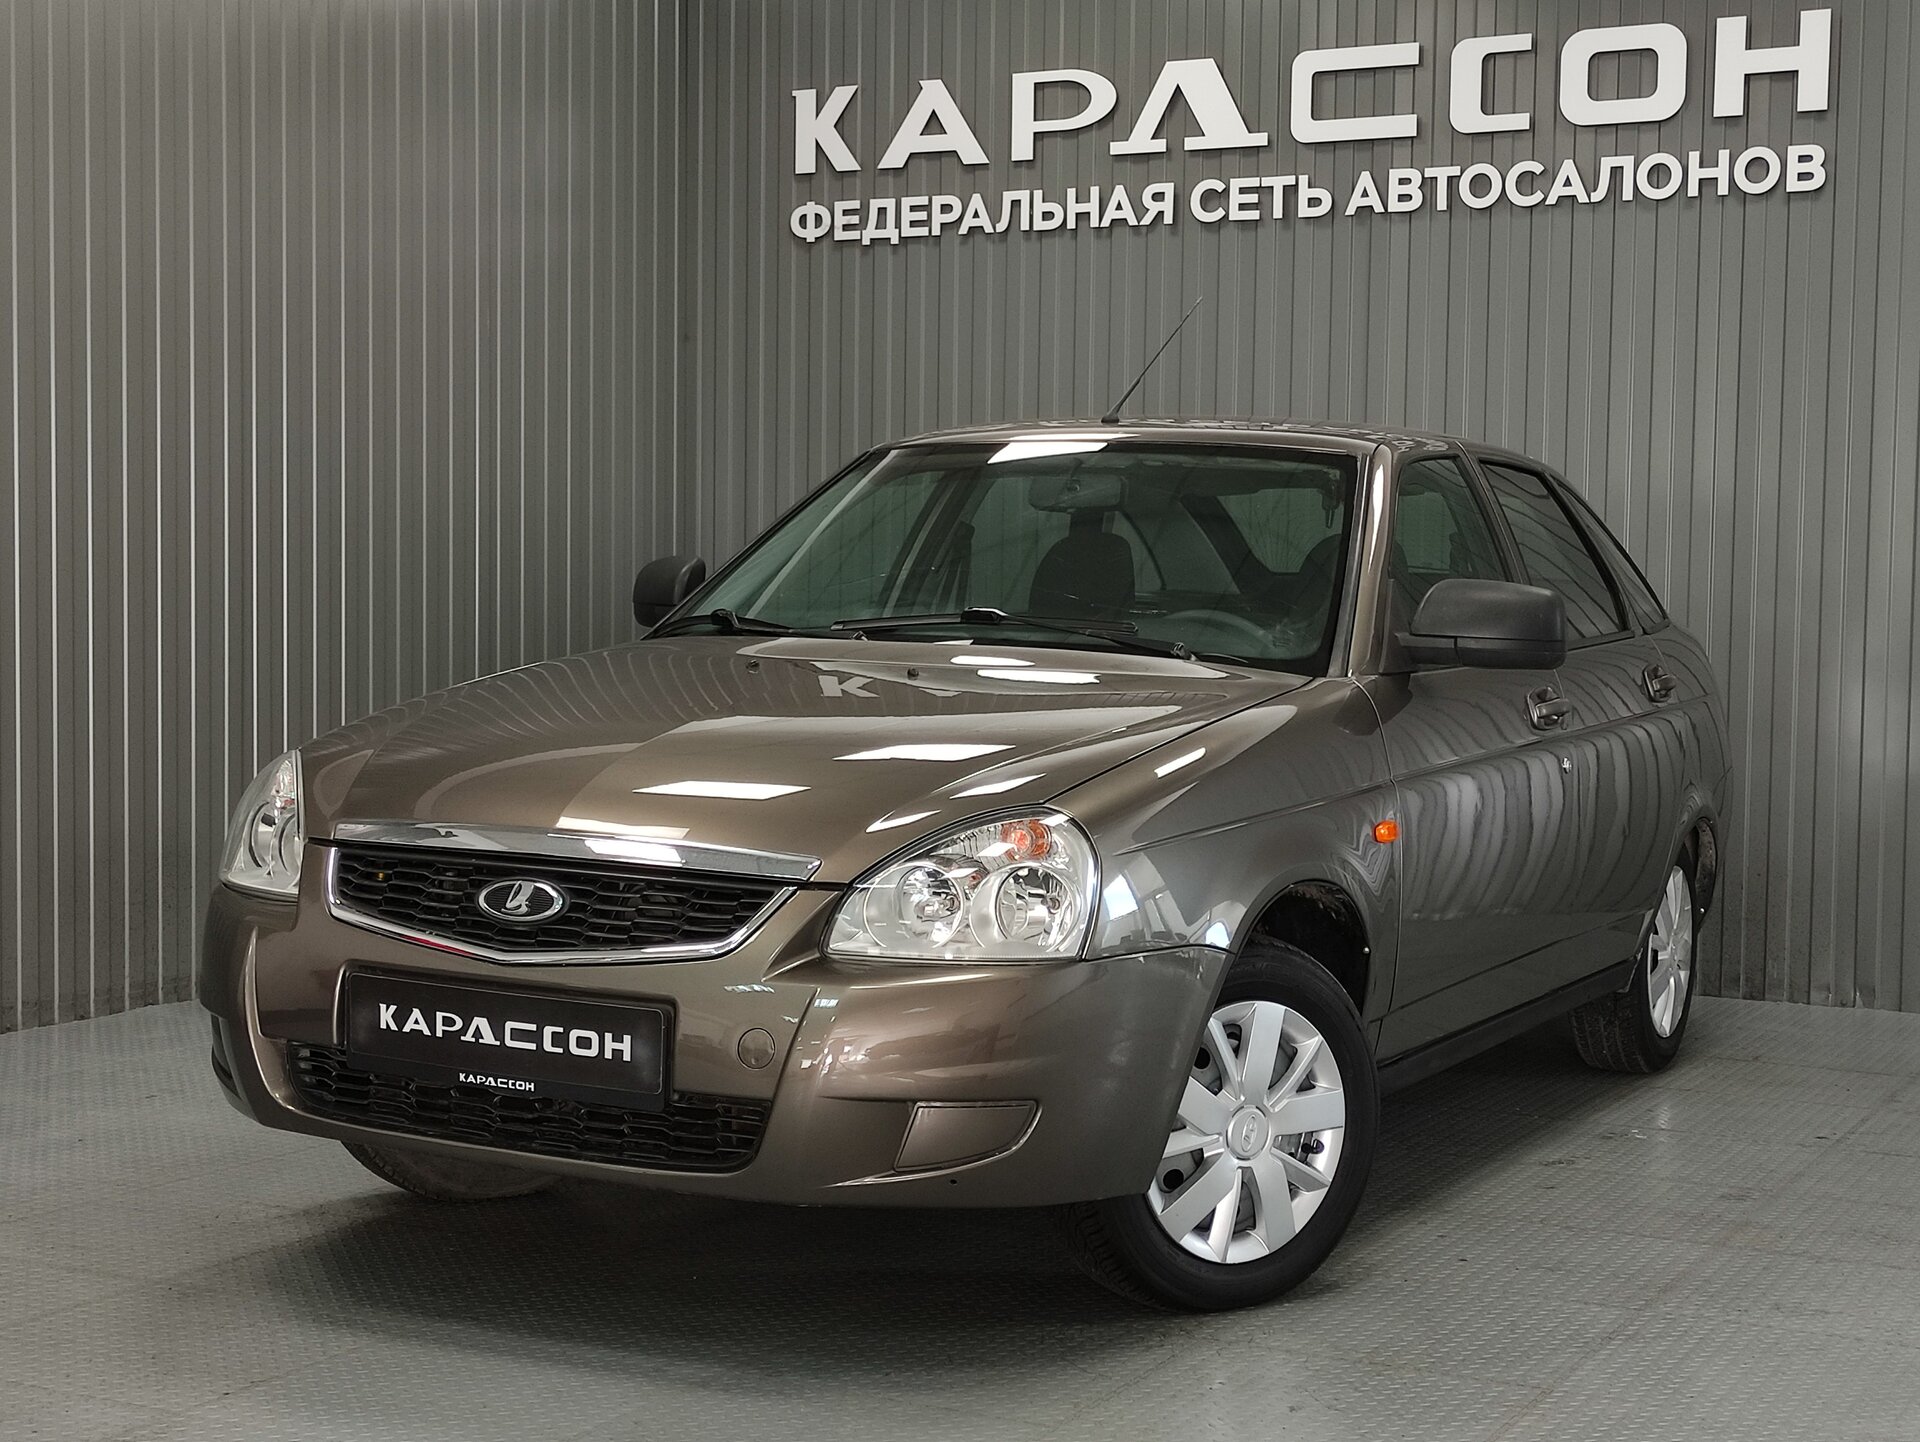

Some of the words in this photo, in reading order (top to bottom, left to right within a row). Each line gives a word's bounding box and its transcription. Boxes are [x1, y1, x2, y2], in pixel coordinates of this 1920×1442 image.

[789, 181, 1176, 246] ФЕДЕРАЛЬНАЯ
[1189, 173, 1333, 223] СЕТЬ
[1344, 143, 1827, 217] АВТОСАЛОНОВ
